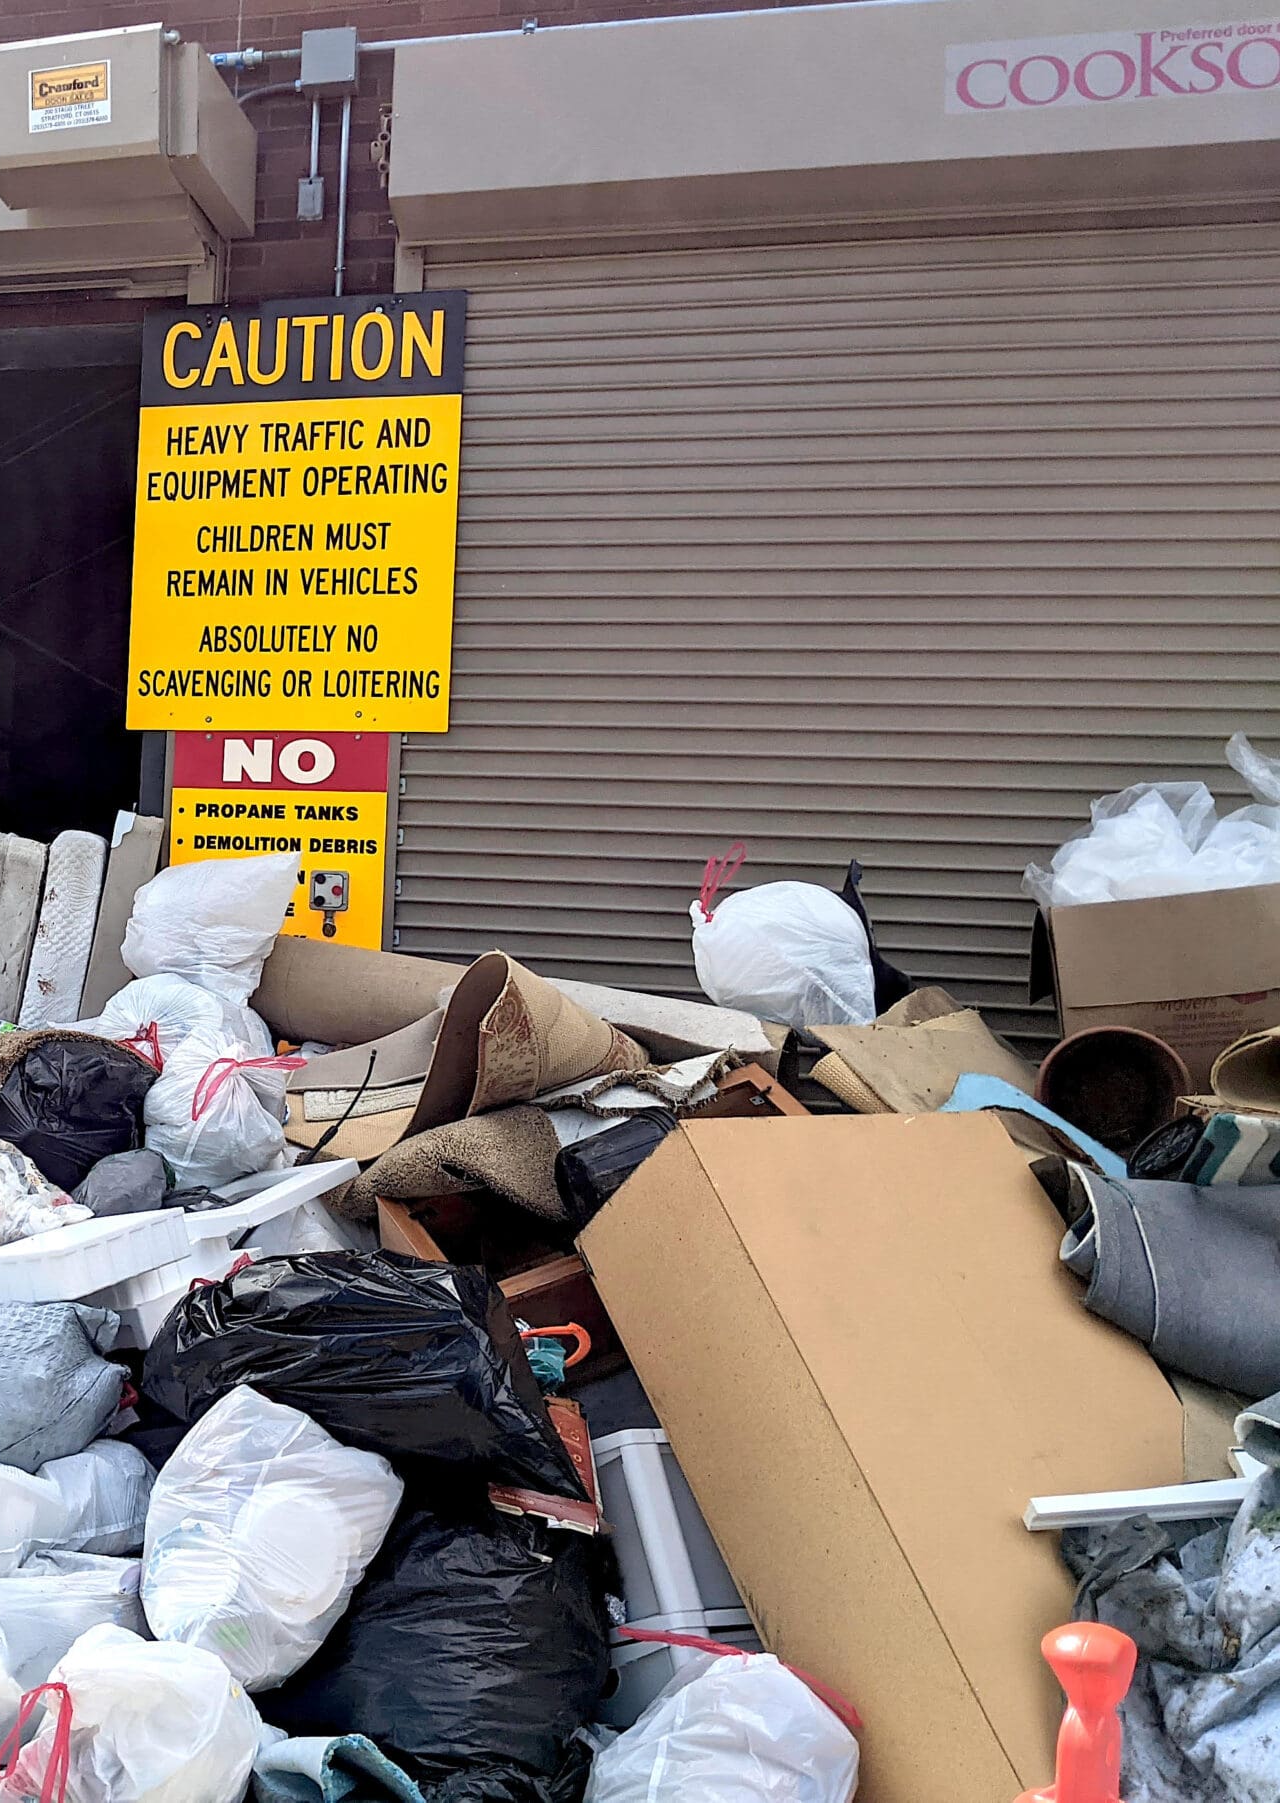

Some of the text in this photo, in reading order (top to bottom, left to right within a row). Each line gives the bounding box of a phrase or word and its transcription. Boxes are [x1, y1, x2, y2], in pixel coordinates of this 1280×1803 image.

[1160, 25, 1232, 42] Preferred
[1237, 23, 1272, 36] door
[39, 75, 99, 97] Crawford
[163, 310, 445, 389] CAUTION
[166, 417, 431, 457] HEAVY TRAFFIC AND
[147, 463, 448, 501] EQUIPMENT OPERATING
[196, 522, 392, 554] CHILDREN MUST
[166, 566, 418, 597] REMAIN IN VEHICLES
[198, 624, 379, 653] ABSOLUTELY NO
[137, 669, 441, 699] SCAVENGING OR LOITERING
[222, 738, 336, 784] NO
[195, 803, 359, 821] PROPANE TANKS
[194, 835, 378, 855] DEMOLITION DEBRIS
